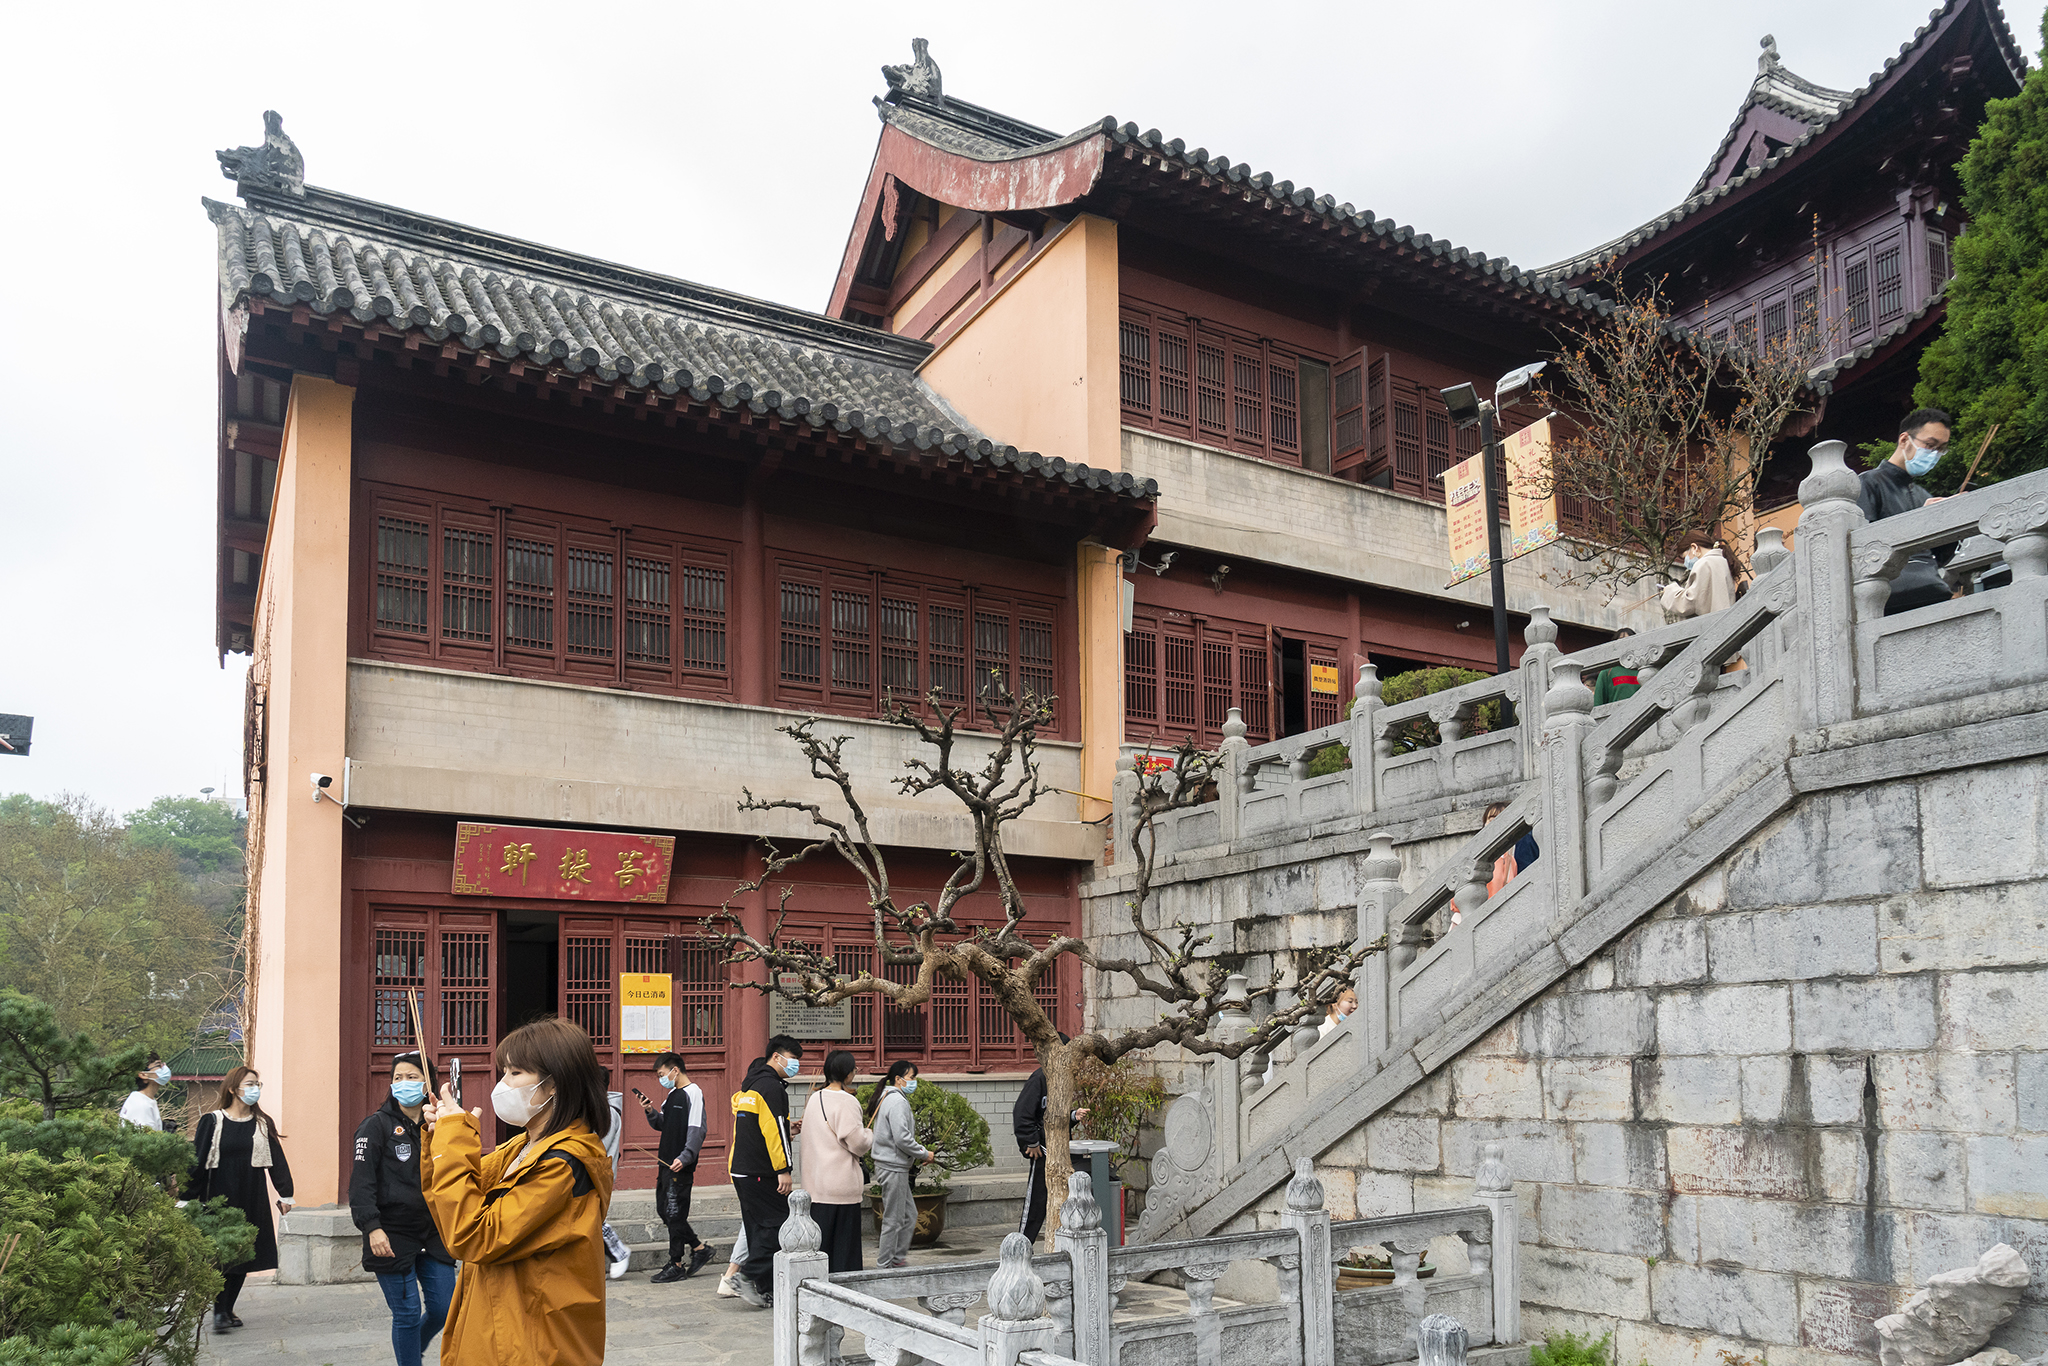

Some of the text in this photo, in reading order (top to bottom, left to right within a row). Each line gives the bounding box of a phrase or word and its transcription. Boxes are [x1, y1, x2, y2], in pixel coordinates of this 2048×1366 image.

[627, 990, 666, 999] 今日已消毒
